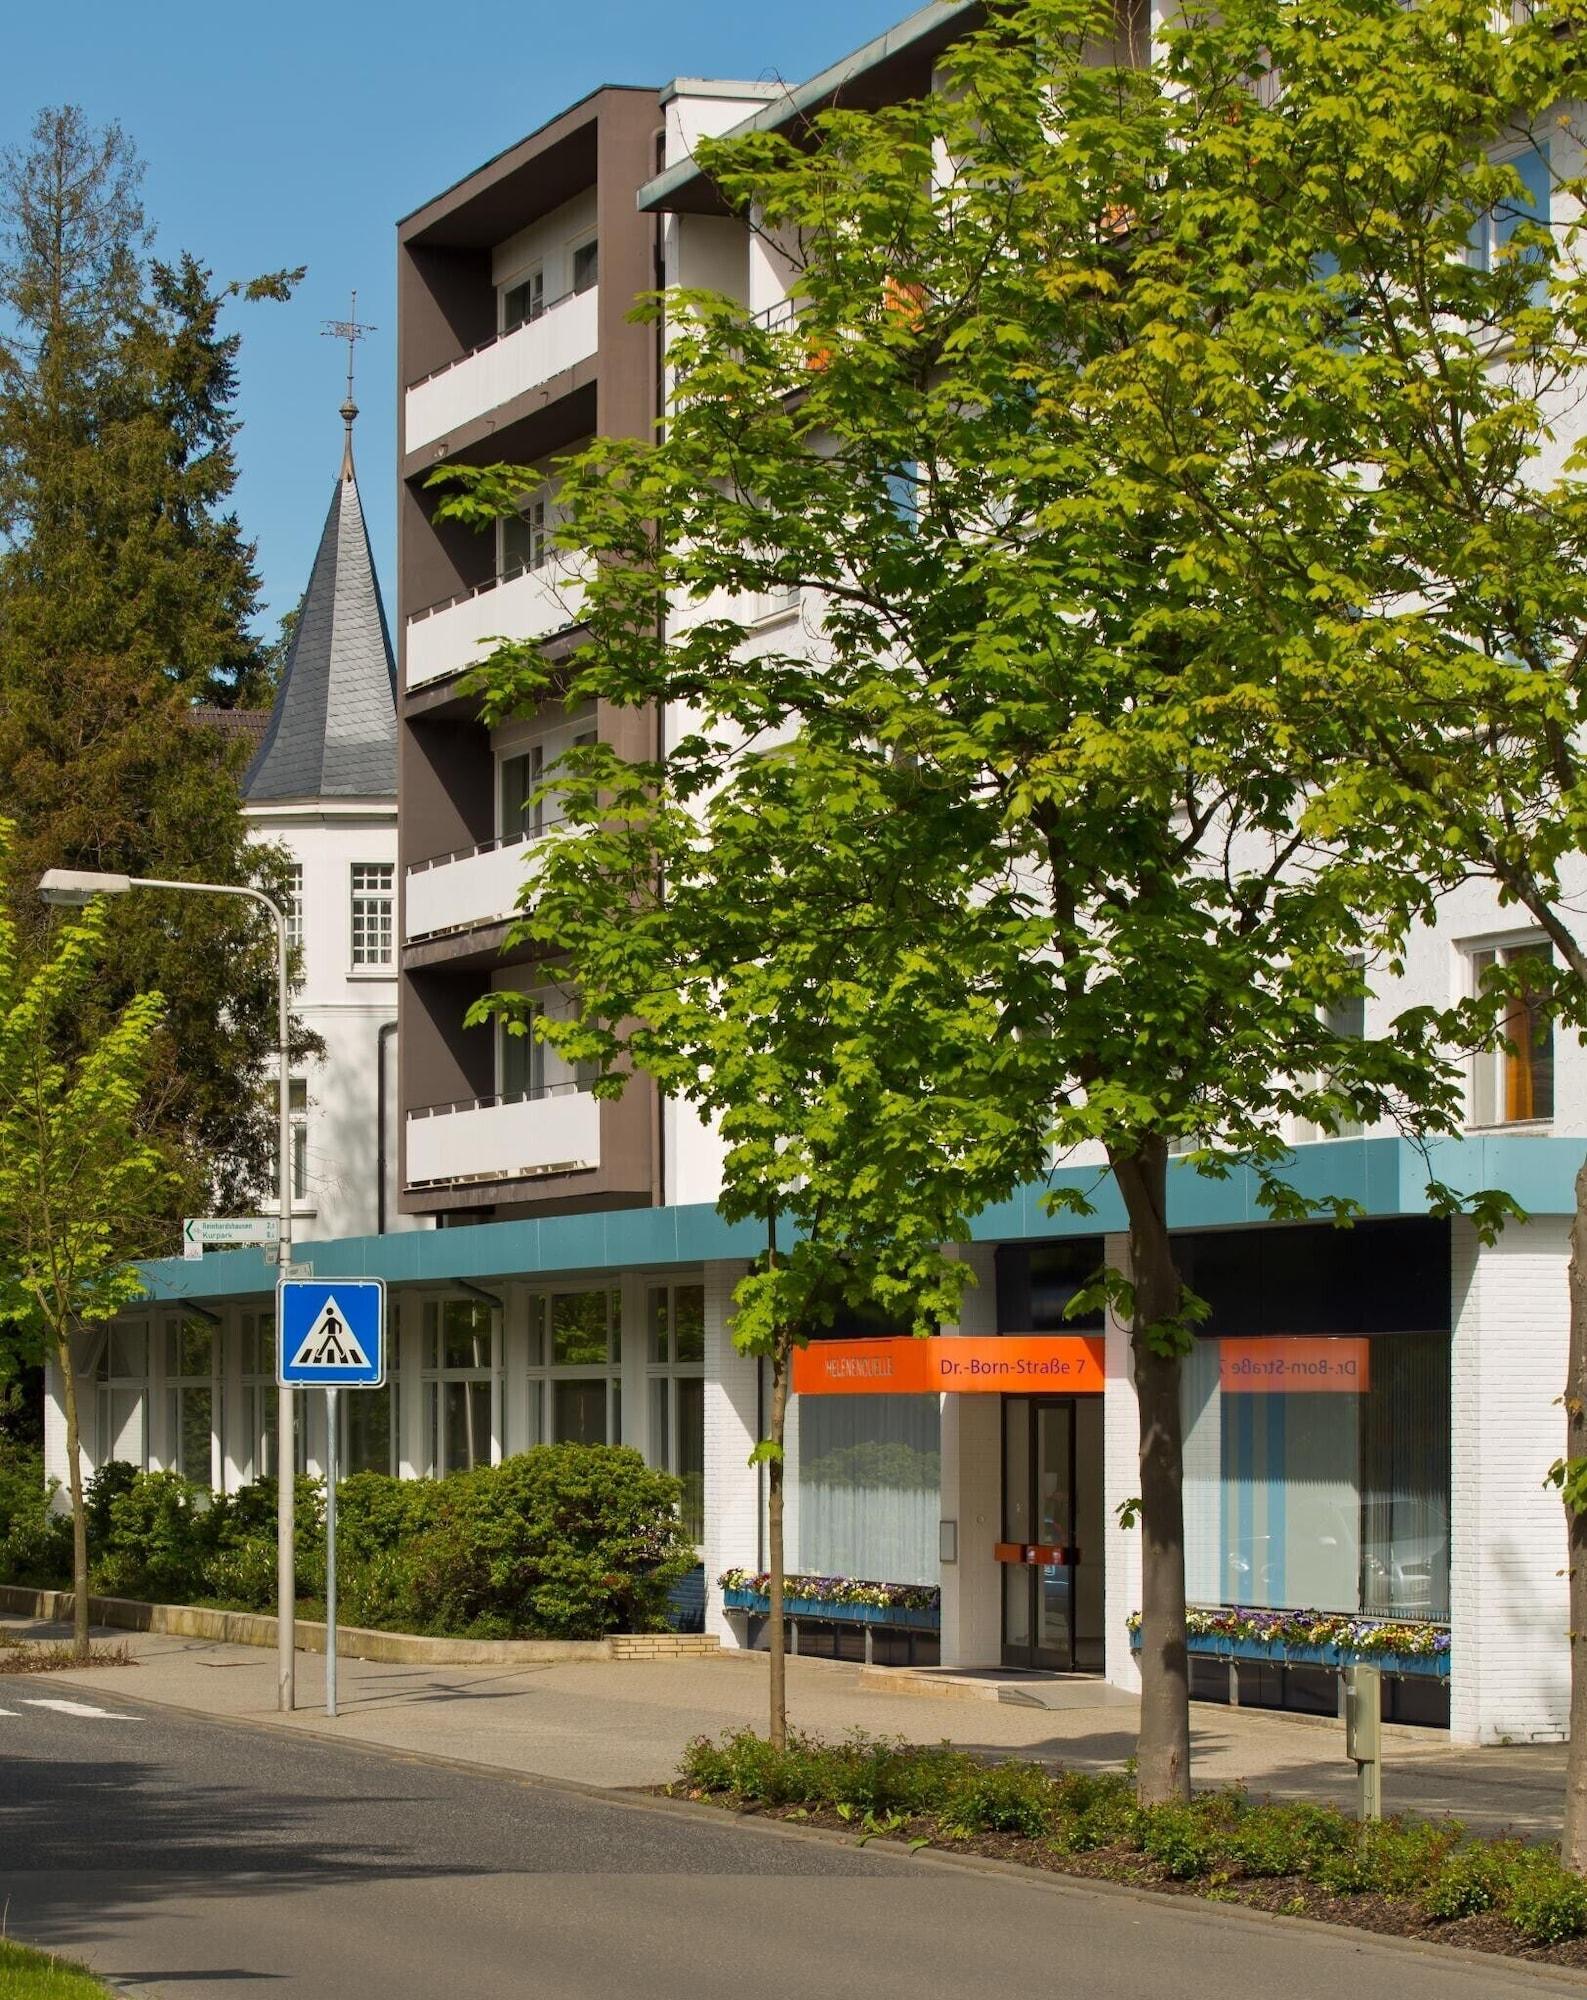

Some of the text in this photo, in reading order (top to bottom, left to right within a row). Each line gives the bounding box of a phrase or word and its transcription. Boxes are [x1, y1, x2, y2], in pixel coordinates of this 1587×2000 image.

[202, 1231, 232, 1240] Kurpark
[941, 1358, 1085, 1375] Dr.-Born-Straße 7
